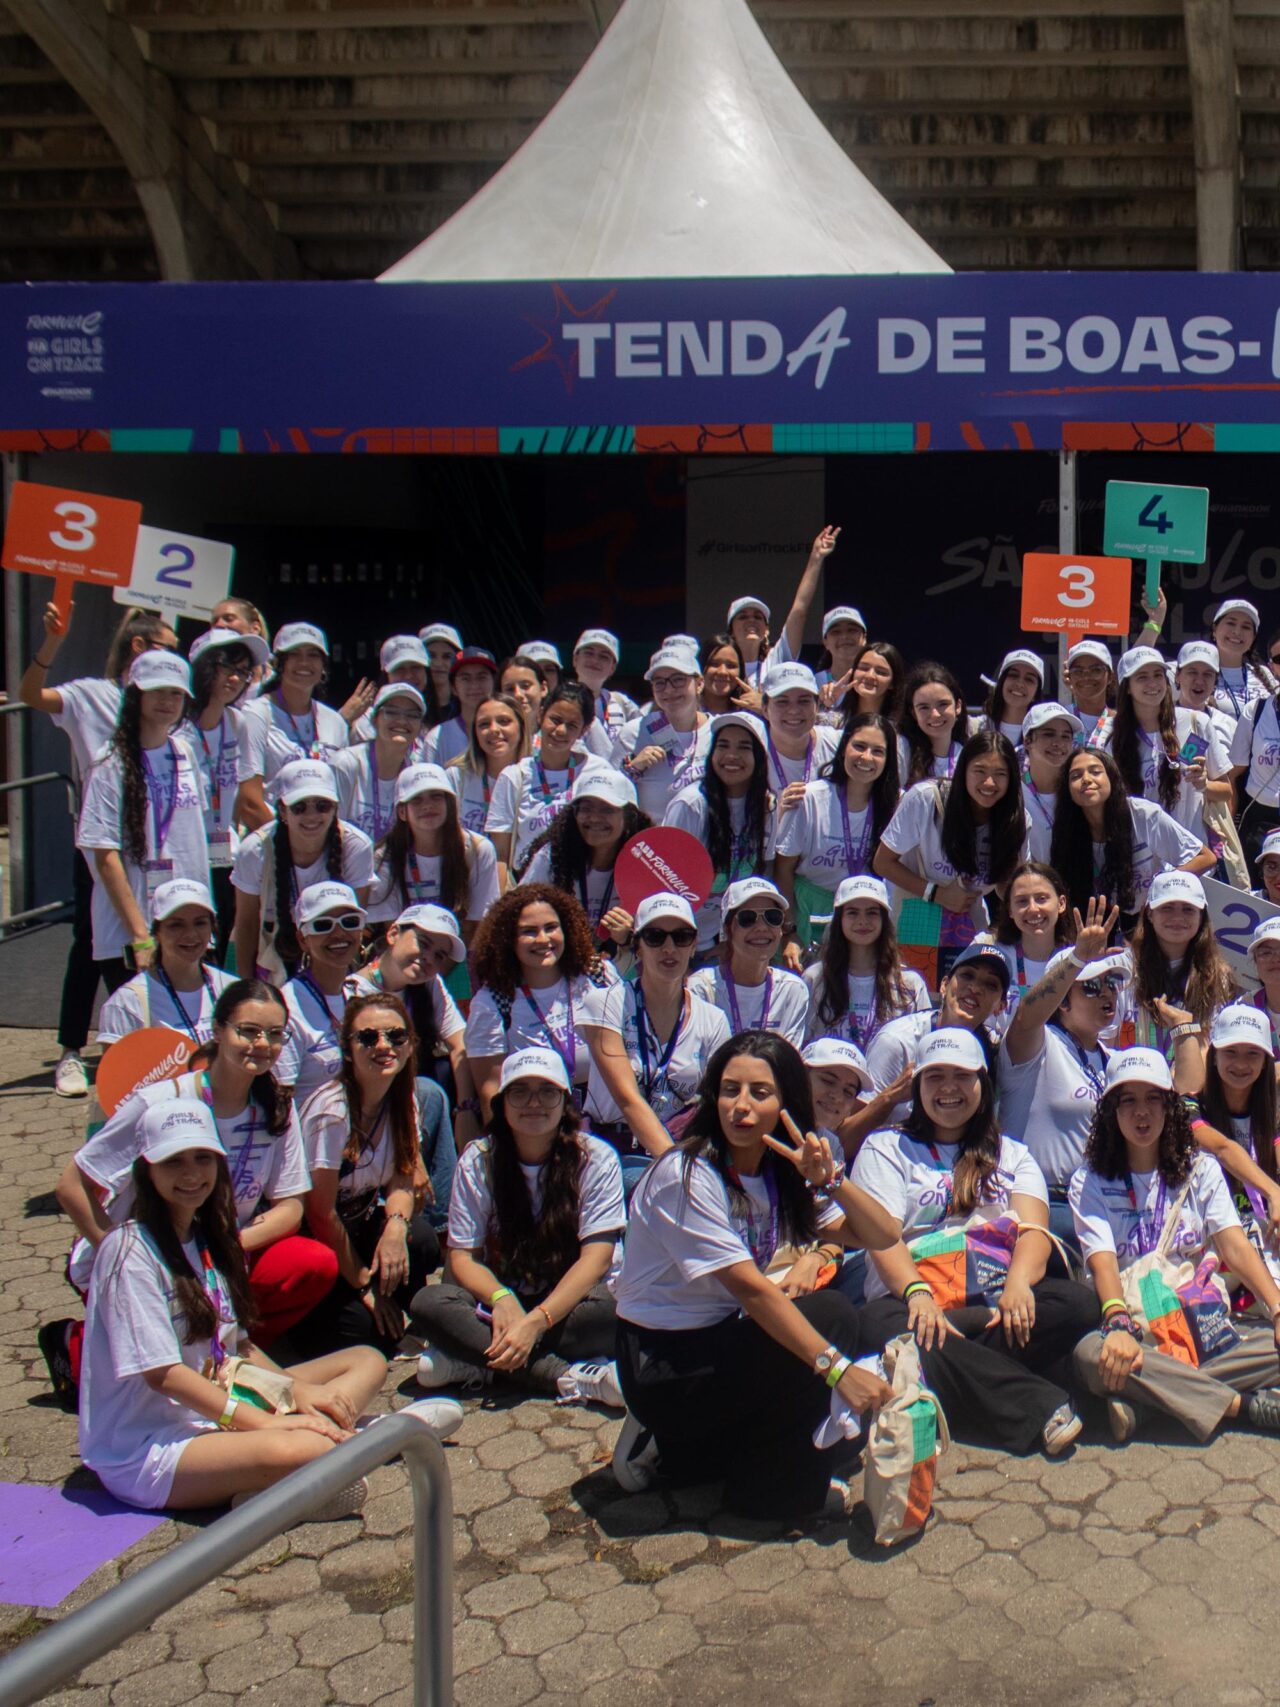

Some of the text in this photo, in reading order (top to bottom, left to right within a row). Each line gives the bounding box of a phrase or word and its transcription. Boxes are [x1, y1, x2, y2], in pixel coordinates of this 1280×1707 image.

[51, 337, 102, 355] GIRLS
[563, 306, 850, 389] TENDA
[878, 317, 986, 373] DE
[49, 501, 97, 551] 3
[1138, 494, 1173, 534] 4
[156, 543, 195, 589] 2
[1057, 565, 1095, 608] 3
[1214, 903, 1260, 955] 2
